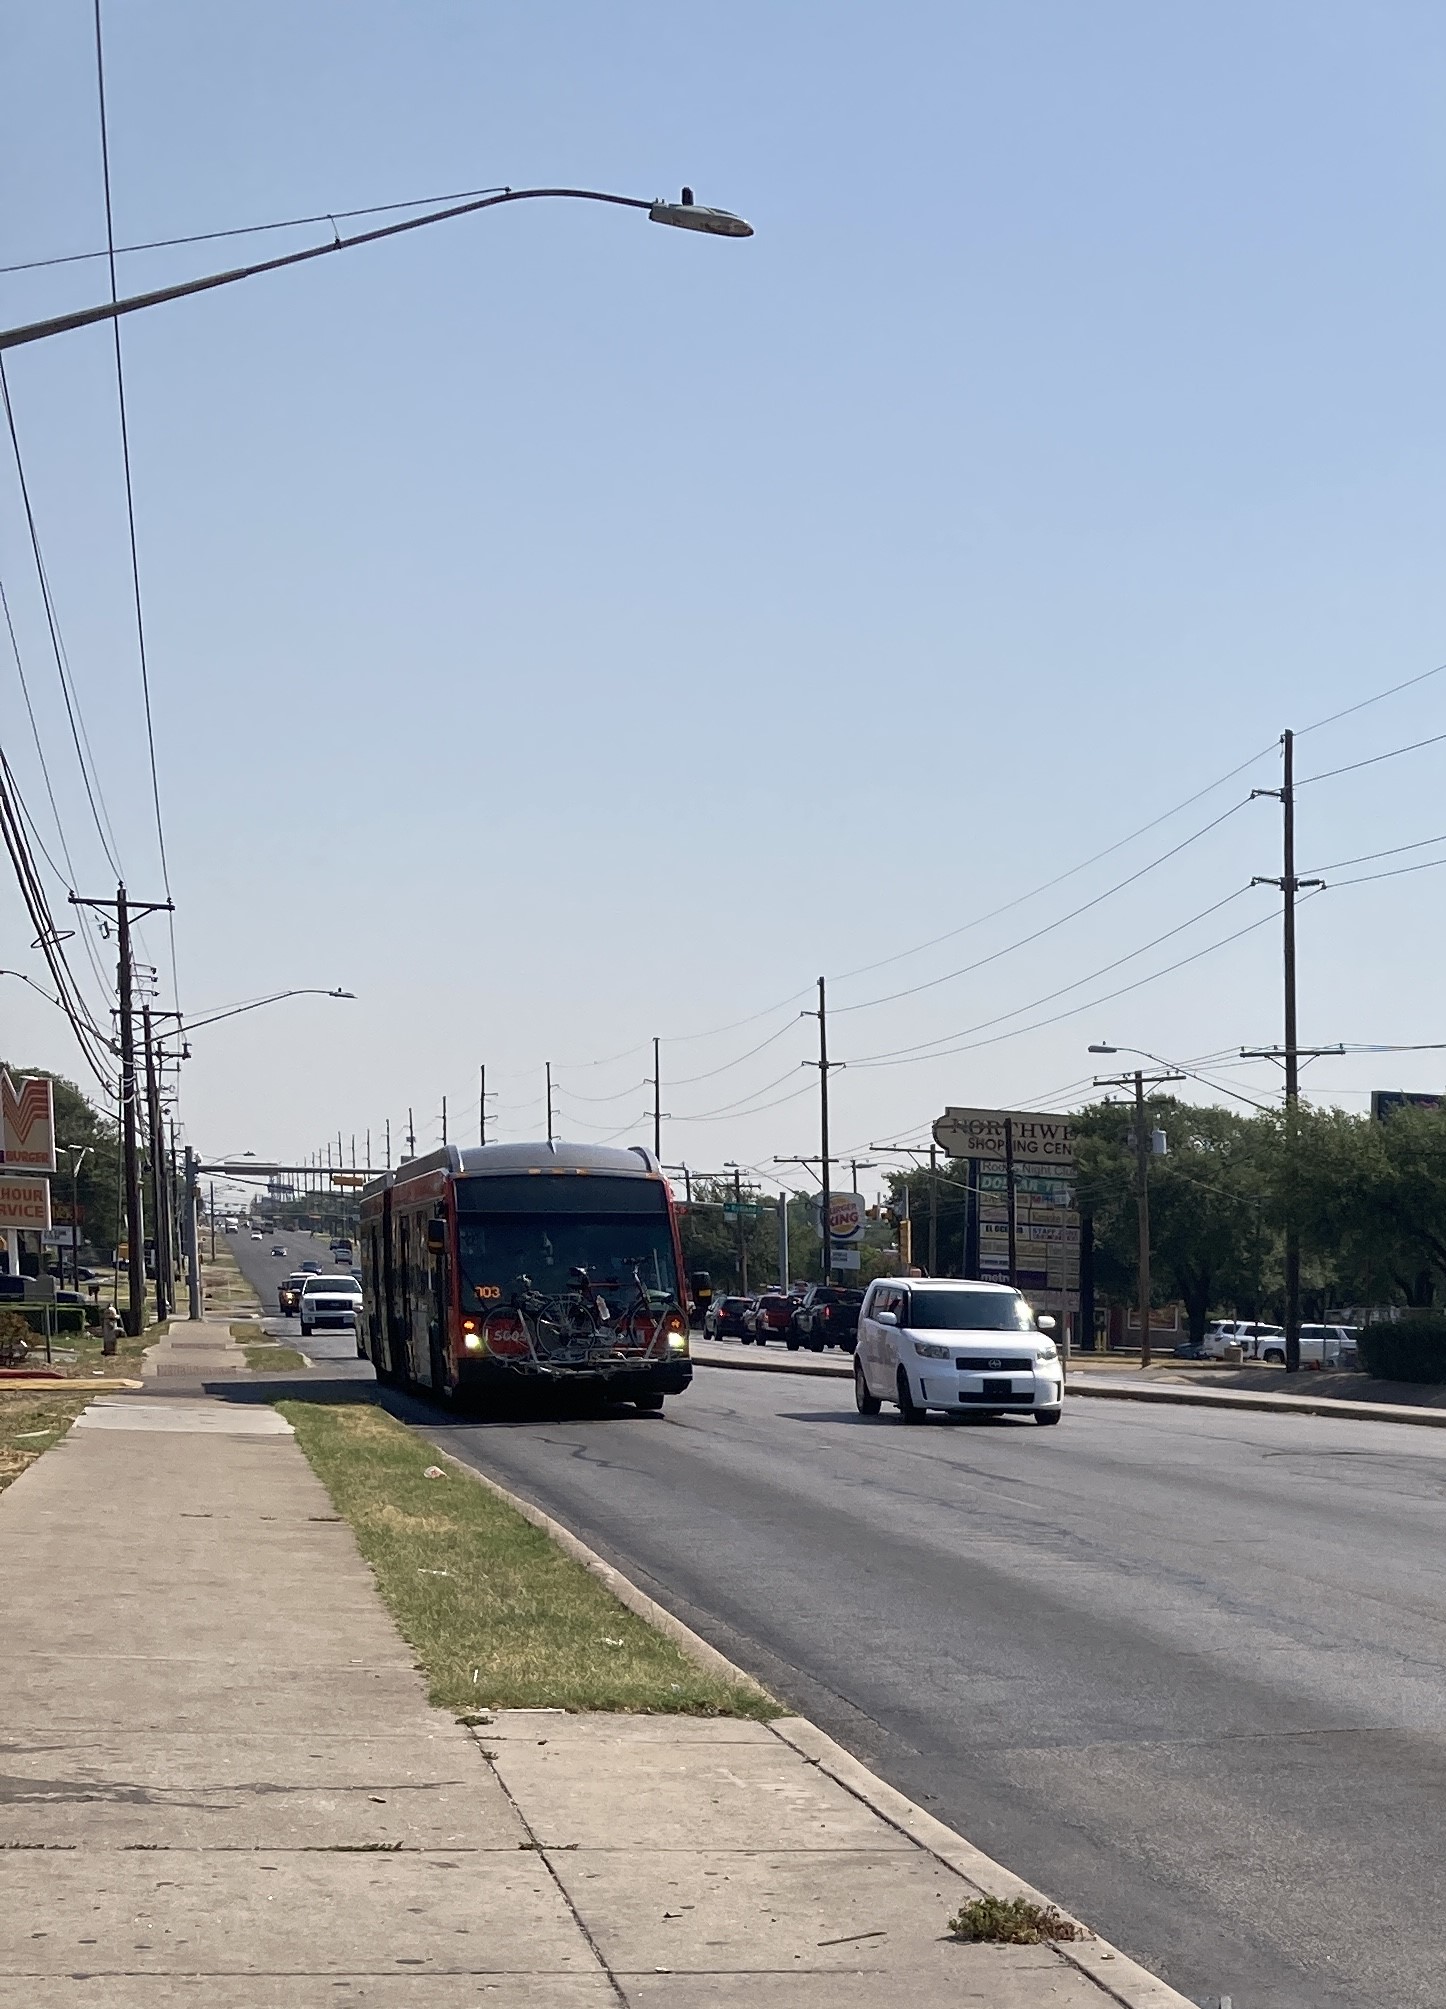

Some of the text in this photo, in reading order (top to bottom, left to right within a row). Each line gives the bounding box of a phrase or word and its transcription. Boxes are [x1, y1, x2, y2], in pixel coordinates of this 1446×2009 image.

[968, 1137, 1038, 1153] SHOPING
[6, 1150, 49, 1163] BURGER
[980, 1174, 1040, 1191] DOLAR
[1, 1187, 43, 1202] HOUR
[828, 1203, 857, 1214] URGER
